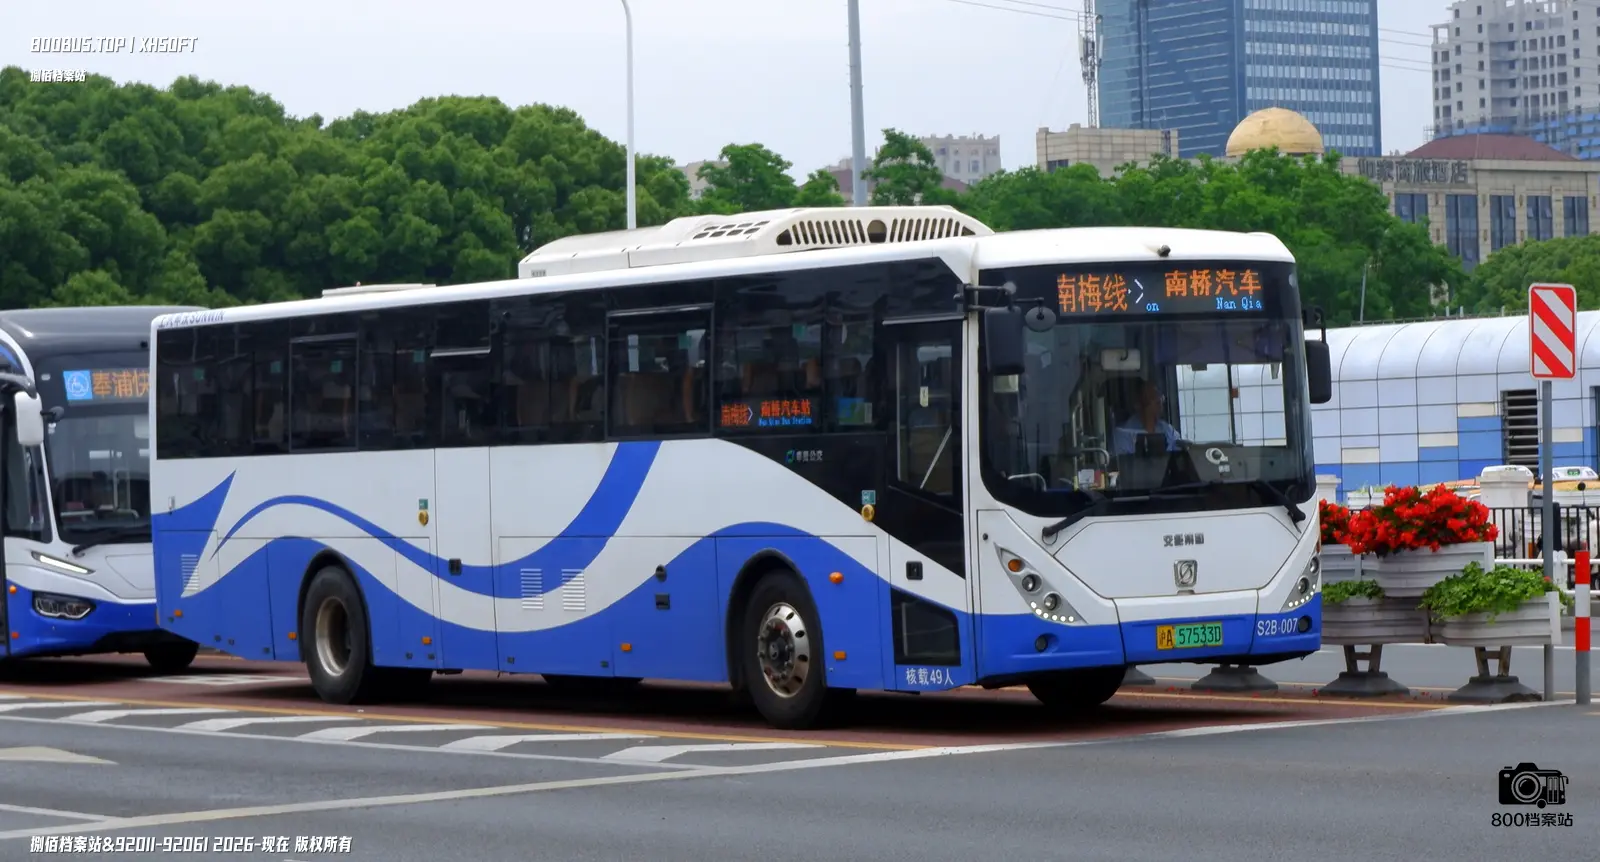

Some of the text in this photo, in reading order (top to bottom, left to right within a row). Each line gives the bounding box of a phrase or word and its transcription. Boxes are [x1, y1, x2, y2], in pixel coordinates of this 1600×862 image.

[1056, 273, 1129, 313] 南梅线
[1164, 269, 1262, 298] 南桥汽车
[1146, 295, 1263, 312] on Nan Qia
[906, 668, 954, 686] 核载49人
